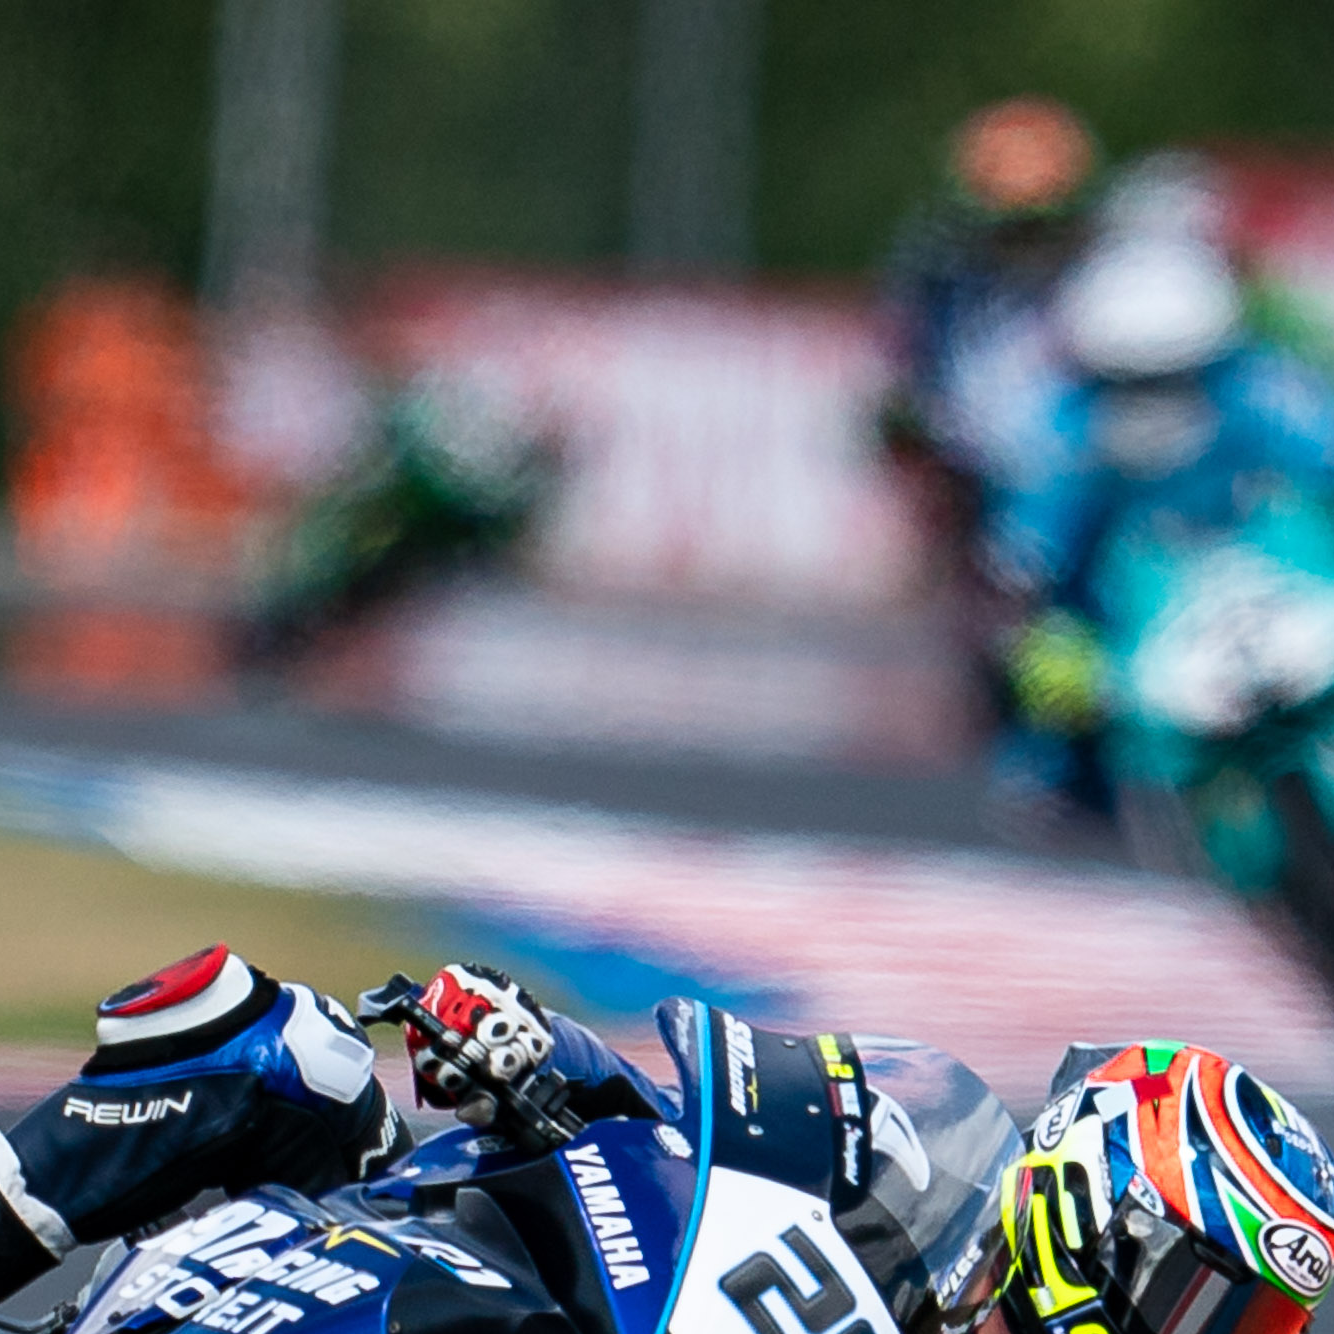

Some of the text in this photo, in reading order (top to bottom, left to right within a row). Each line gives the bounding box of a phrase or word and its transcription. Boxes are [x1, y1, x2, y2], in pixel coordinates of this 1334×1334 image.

[64, 1091, 192, 1125] REWIN
[565, 1143, 650, 1289] YAMAHA
[1268, 1233, 1329, 1285] Arai
